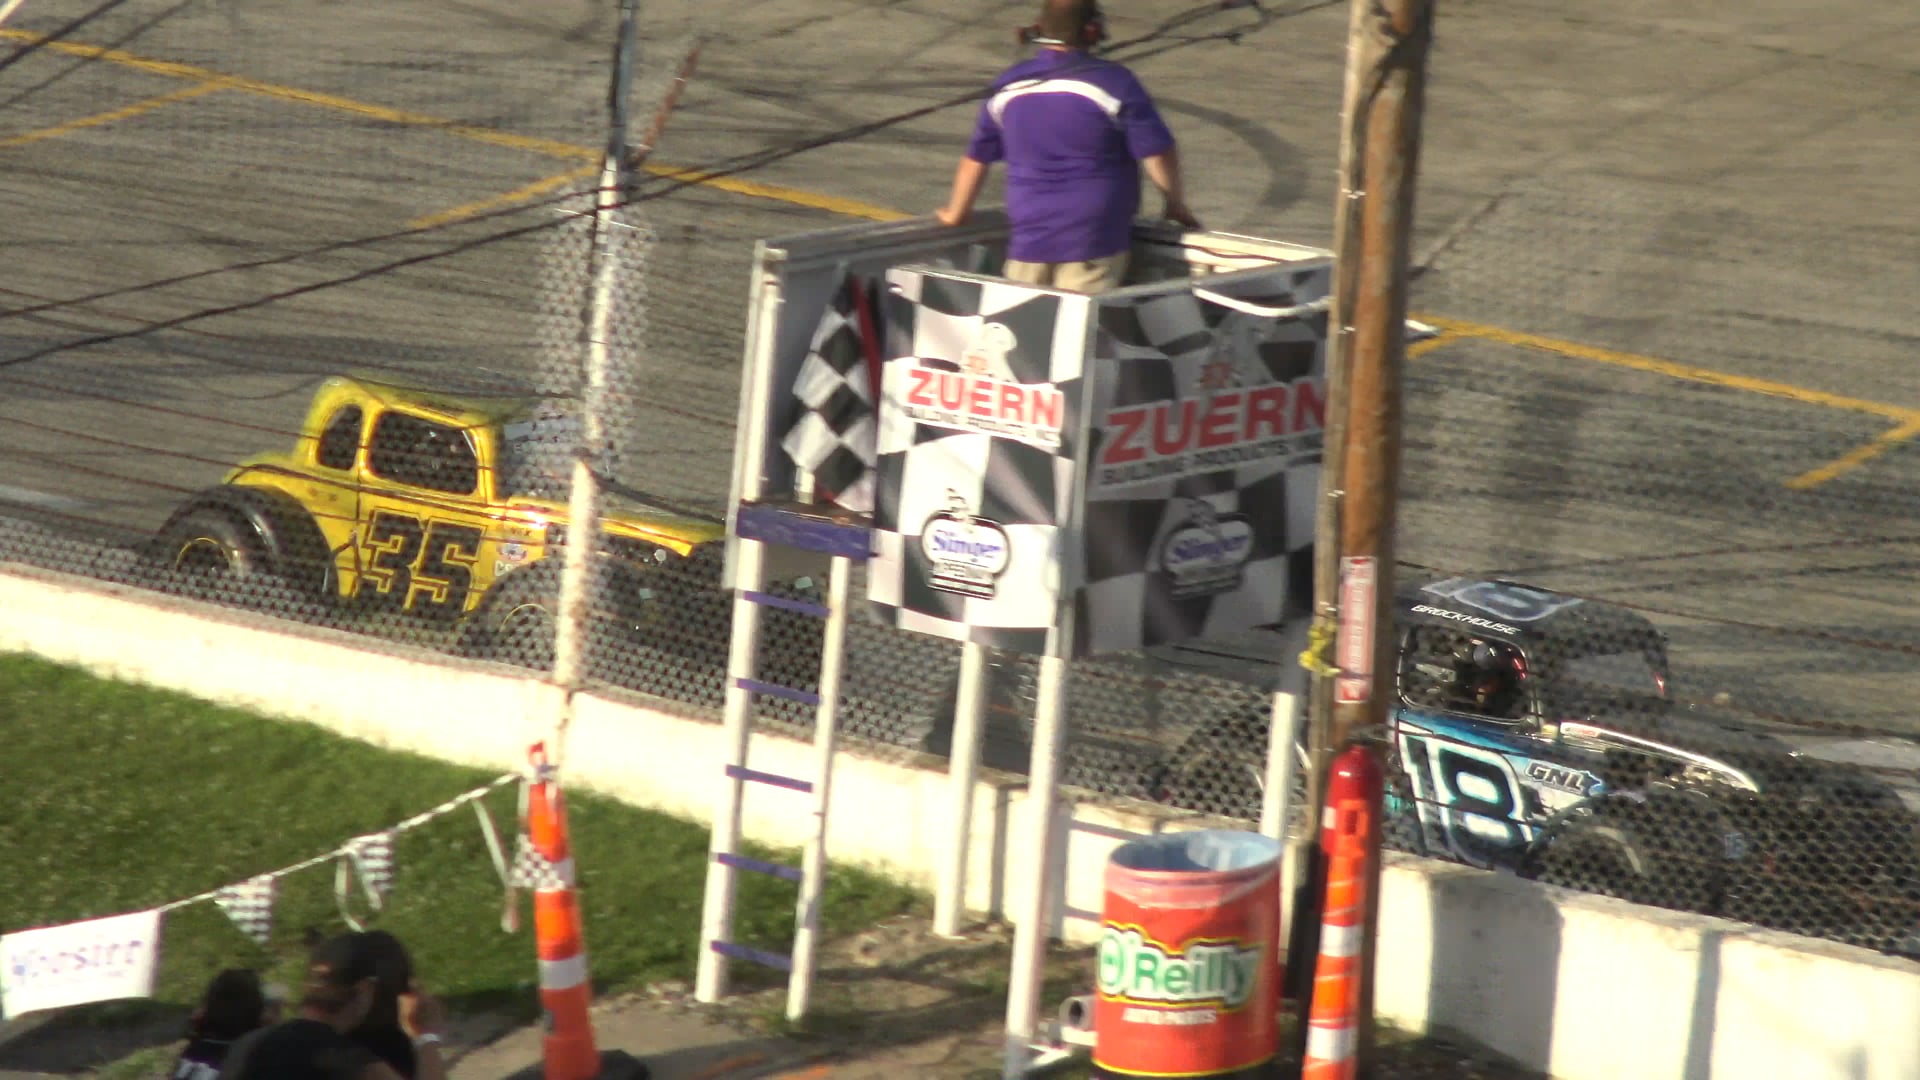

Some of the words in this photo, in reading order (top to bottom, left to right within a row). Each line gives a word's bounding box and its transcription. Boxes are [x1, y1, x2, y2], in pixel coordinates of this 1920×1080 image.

[908, 369, 1063, 428] ZUERN
[1103, 381, 1326, 465] ZUERN
[1411, 604, 1522, 635] BROCKHOUSE
[1525, 758, 1589, 796] GNL
